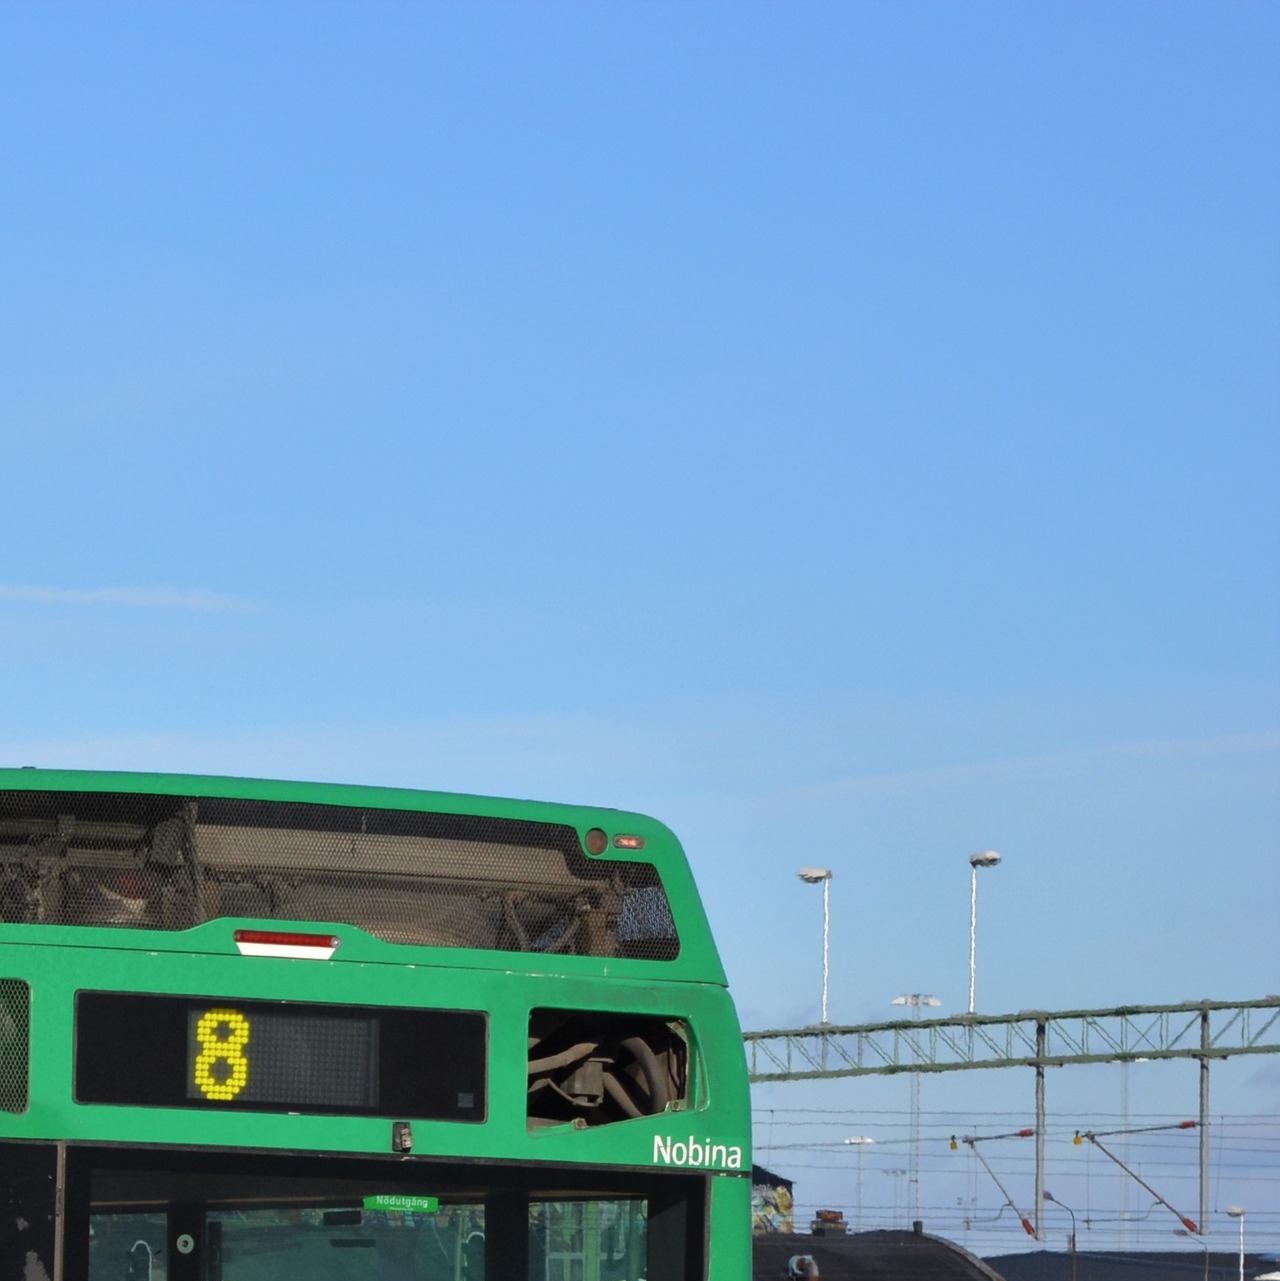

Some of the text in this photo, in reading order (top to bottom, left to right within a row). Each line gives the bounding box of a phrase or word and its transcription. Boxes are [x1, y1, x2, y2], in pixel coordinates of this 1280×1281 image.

[195, 1010, 249, 1100] 8
[653, 1135, 741, 1168] Nobina
[376, 1196, 428, 1208] Nödutgång
